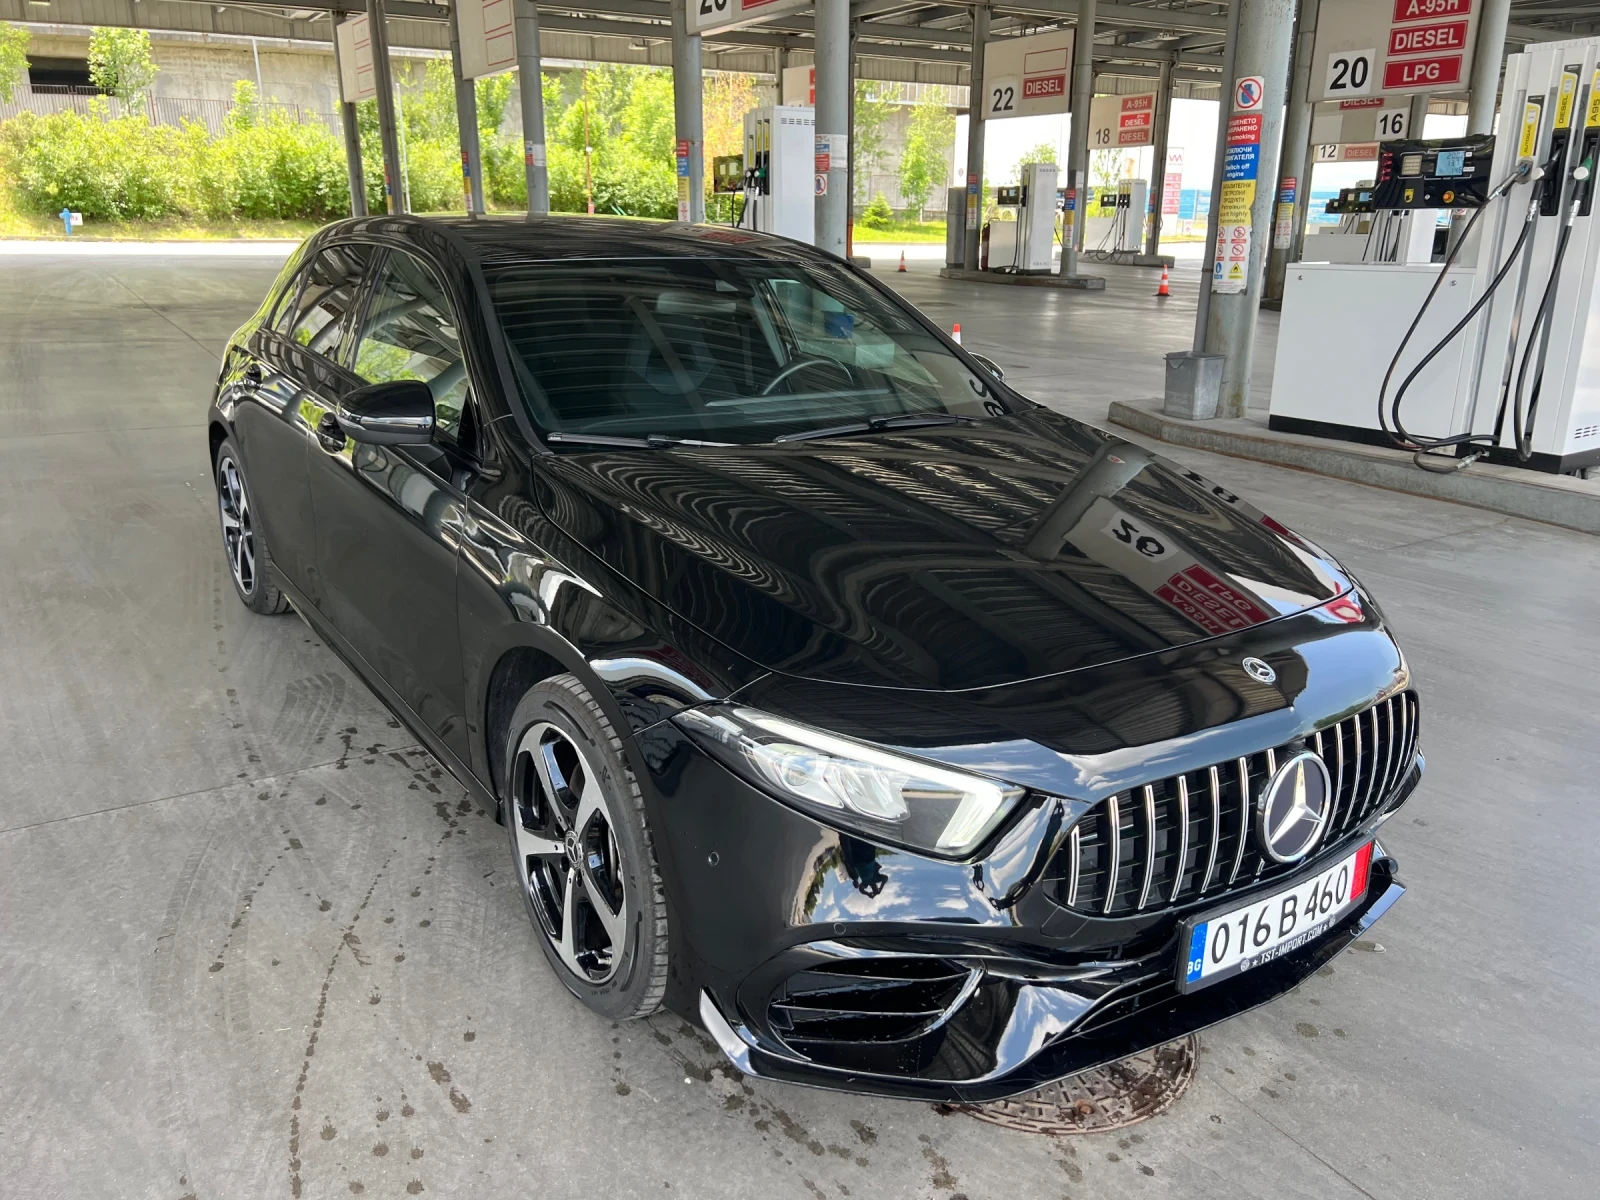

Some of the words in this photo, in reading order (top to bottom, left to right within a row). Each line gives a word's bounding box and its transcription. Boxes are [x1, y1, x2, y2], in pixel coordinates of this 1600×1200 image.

[1394, 28, 1459, 50] DIESEL
[1329, 57, 1369, 90] 20
[1402, 63, 1440, 82] LPG
[1026, 79, 1061, 95] DIESEL
[992, 87, 1014, 112] 22
[1126, 99, 1148, 109] A-95H
[1124, 118, 1145, 126] DIESEL
[1379, 113, 1403, 135] 16
[1095, 128, 1110, 145] 18
[1121, 132, 1146, 142] DIESEL
[1320, 145, 1336, 158] 12
[1347, 149, 1373, 157] DIESEL
[1241, 162, 1251, 170] off
[1211, 904, 1271, 964] 016
[1278, 894, 1298, 939] B
[1303, 864, 1348, 921] 460
[1260, 925, 1323, 965] TST-IMPORT.COM
[1187, 959, 1201, 974] BG
